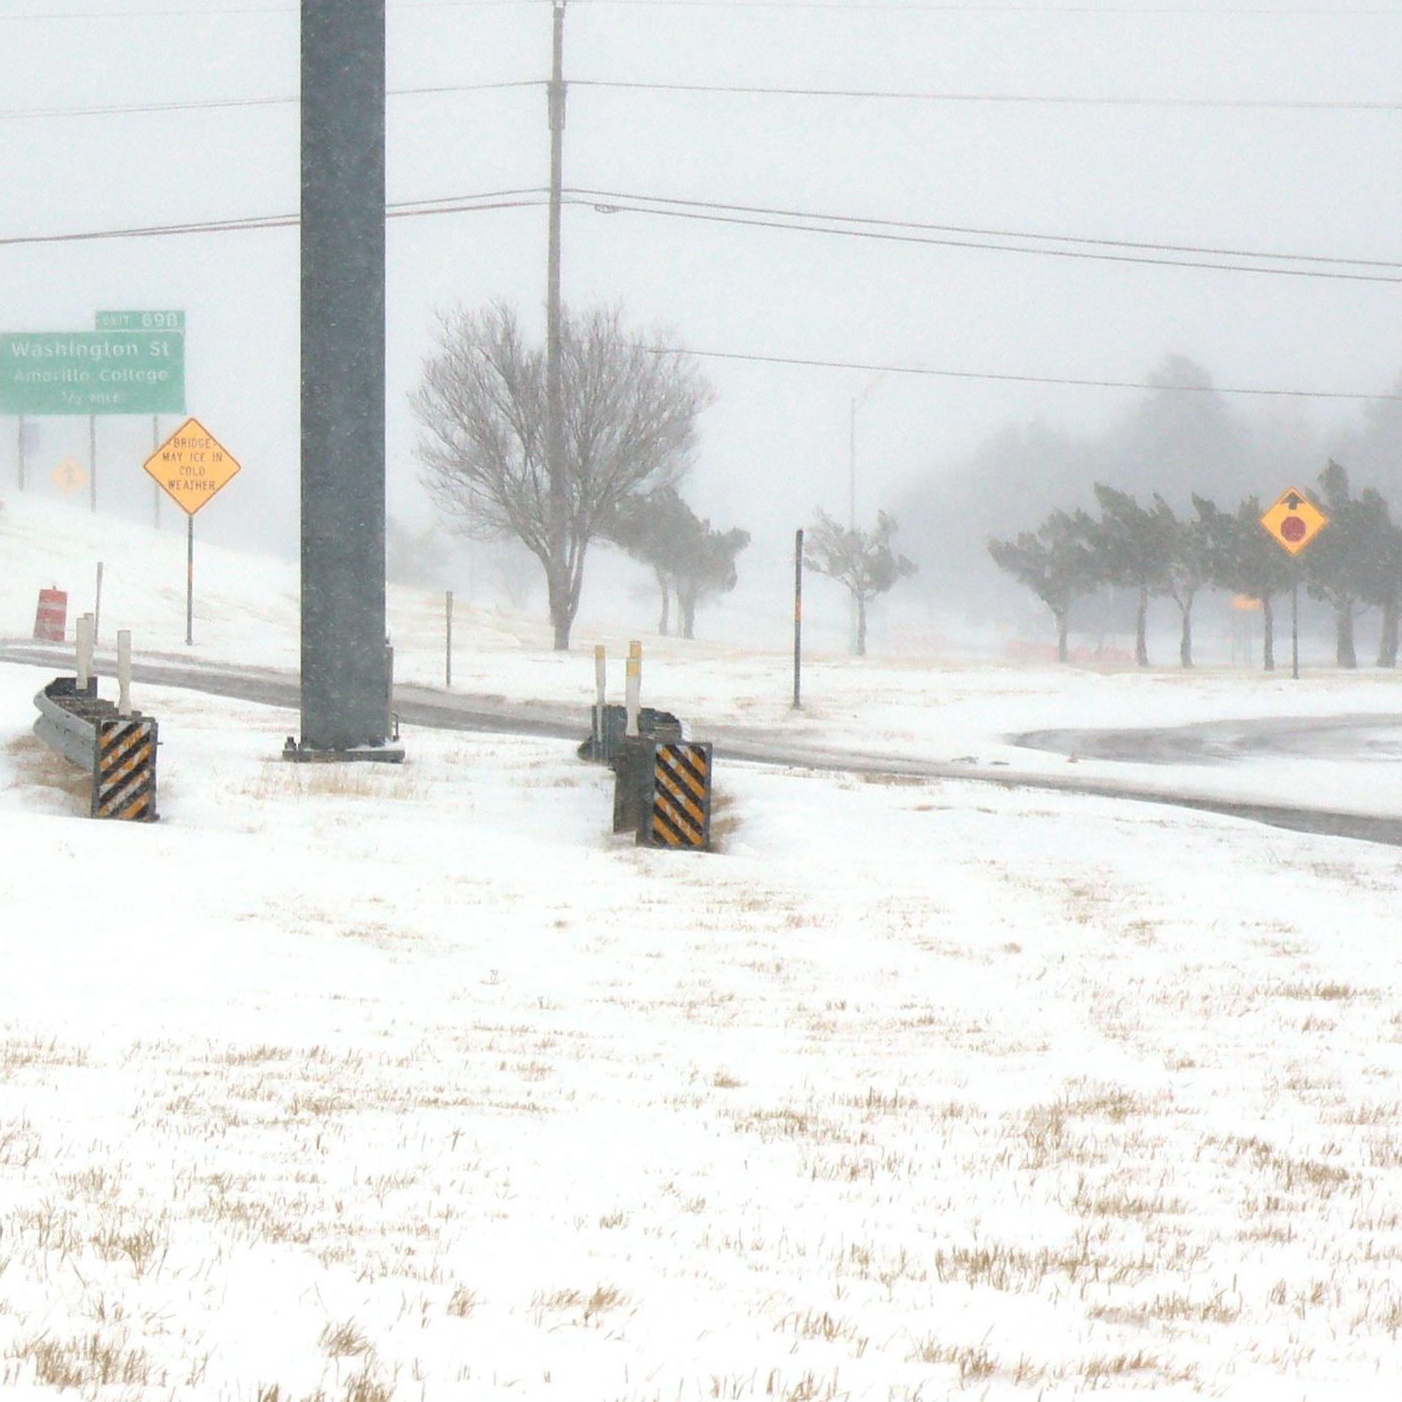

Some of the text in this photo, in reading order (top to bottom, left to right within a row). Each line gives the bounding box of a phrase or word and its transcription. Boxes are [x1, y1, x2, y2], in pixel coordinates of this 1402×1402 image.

[11, 340, 171, 361] Washington St
[13, 368, 169, 384] Amarillo College
[173, 438, 211, 449] BRIDGE
[162, 452, 223, 462] MAY ICE IN
[179, 466, 206, 476] COLD
[168, 480, 216, 491] WEATHER
